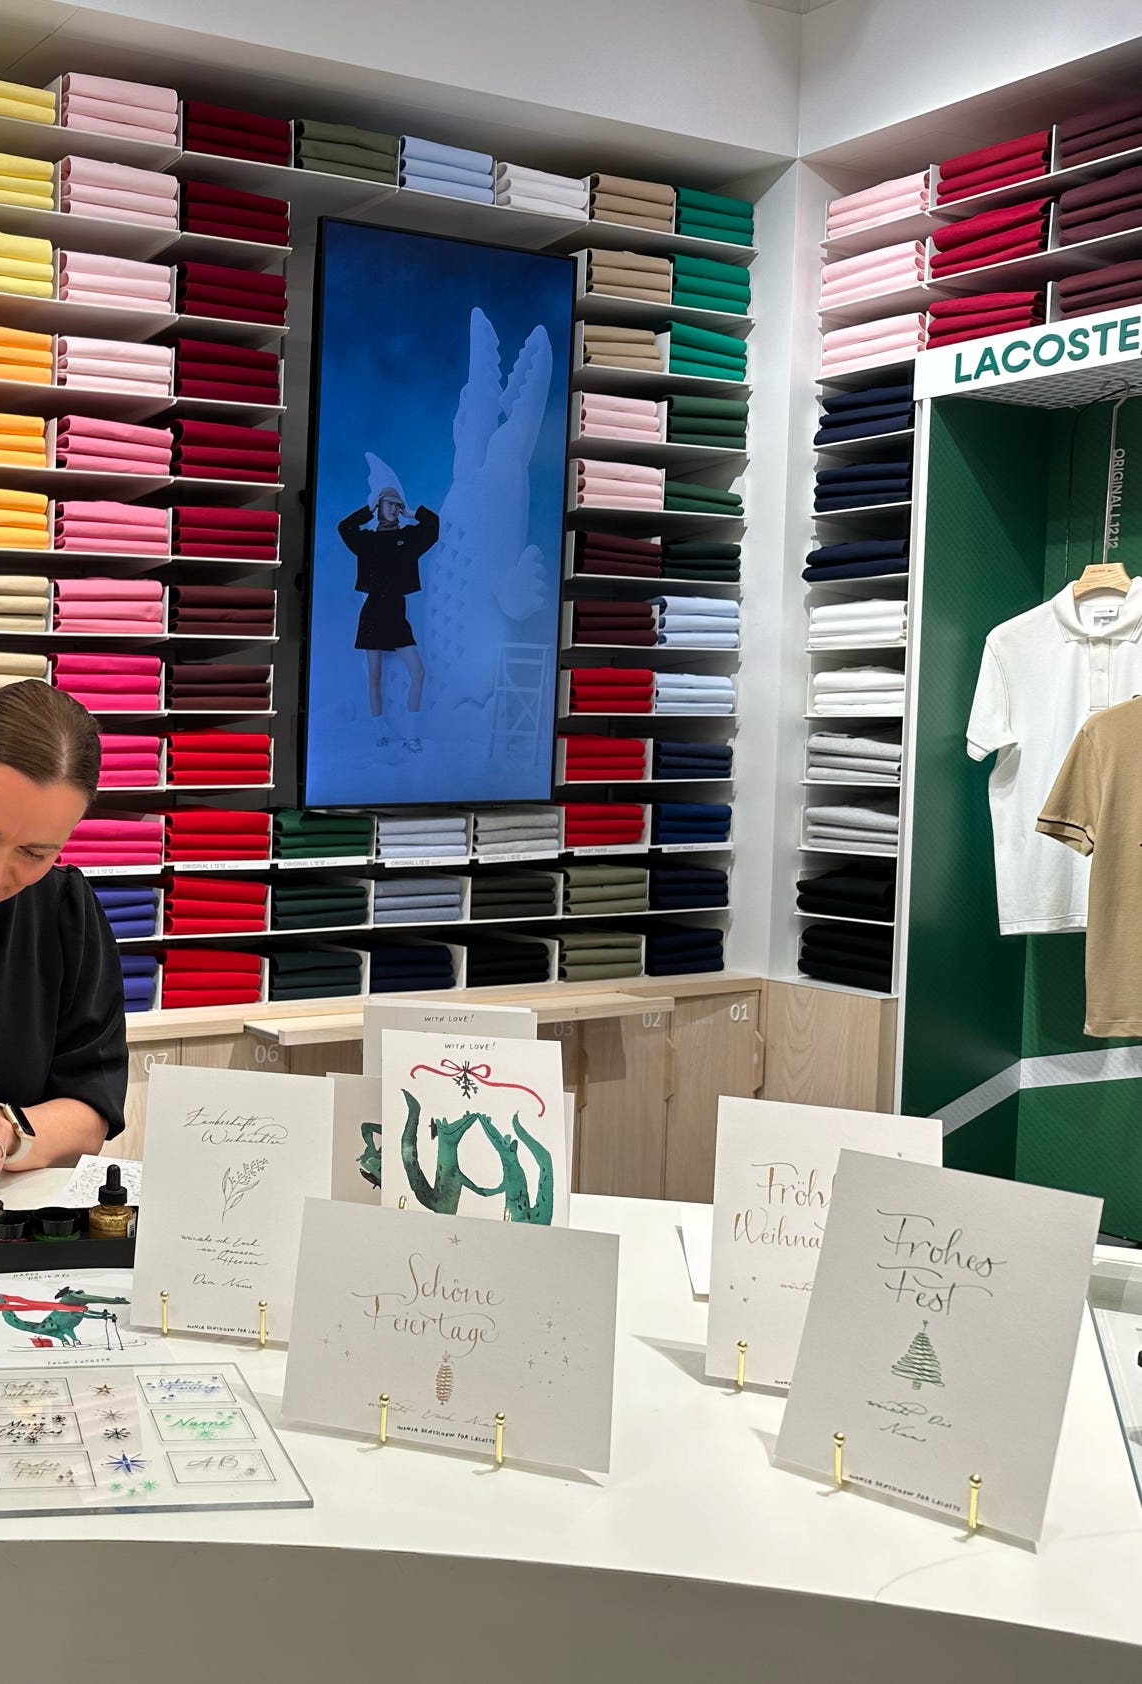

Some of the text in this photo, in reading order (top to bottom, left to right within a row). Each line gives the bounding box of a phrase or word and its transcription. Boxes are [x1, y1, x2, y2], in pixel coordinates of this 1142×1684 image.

[955, 315, 1142, 384] LACOSTE
[1110, 448, 1126, 513] ORIGINAL
[643, 1012, 662, 1029] 02
[730, 1003, 749, 1022] 01
[254, 1043, 280, 1064] 06
[734, 1207, 825, 1249] Weihna
[876, 1208, 1008, 1278] Frohes
[398, 1252, 507, 1306] Schöne
[876, 1263, 994, 1317] Fest
[350, 1291, 500, 1359] Feiertage
[0, 1420, 46, 1433] Merry
[169, 1416, 234, 1428] Name
